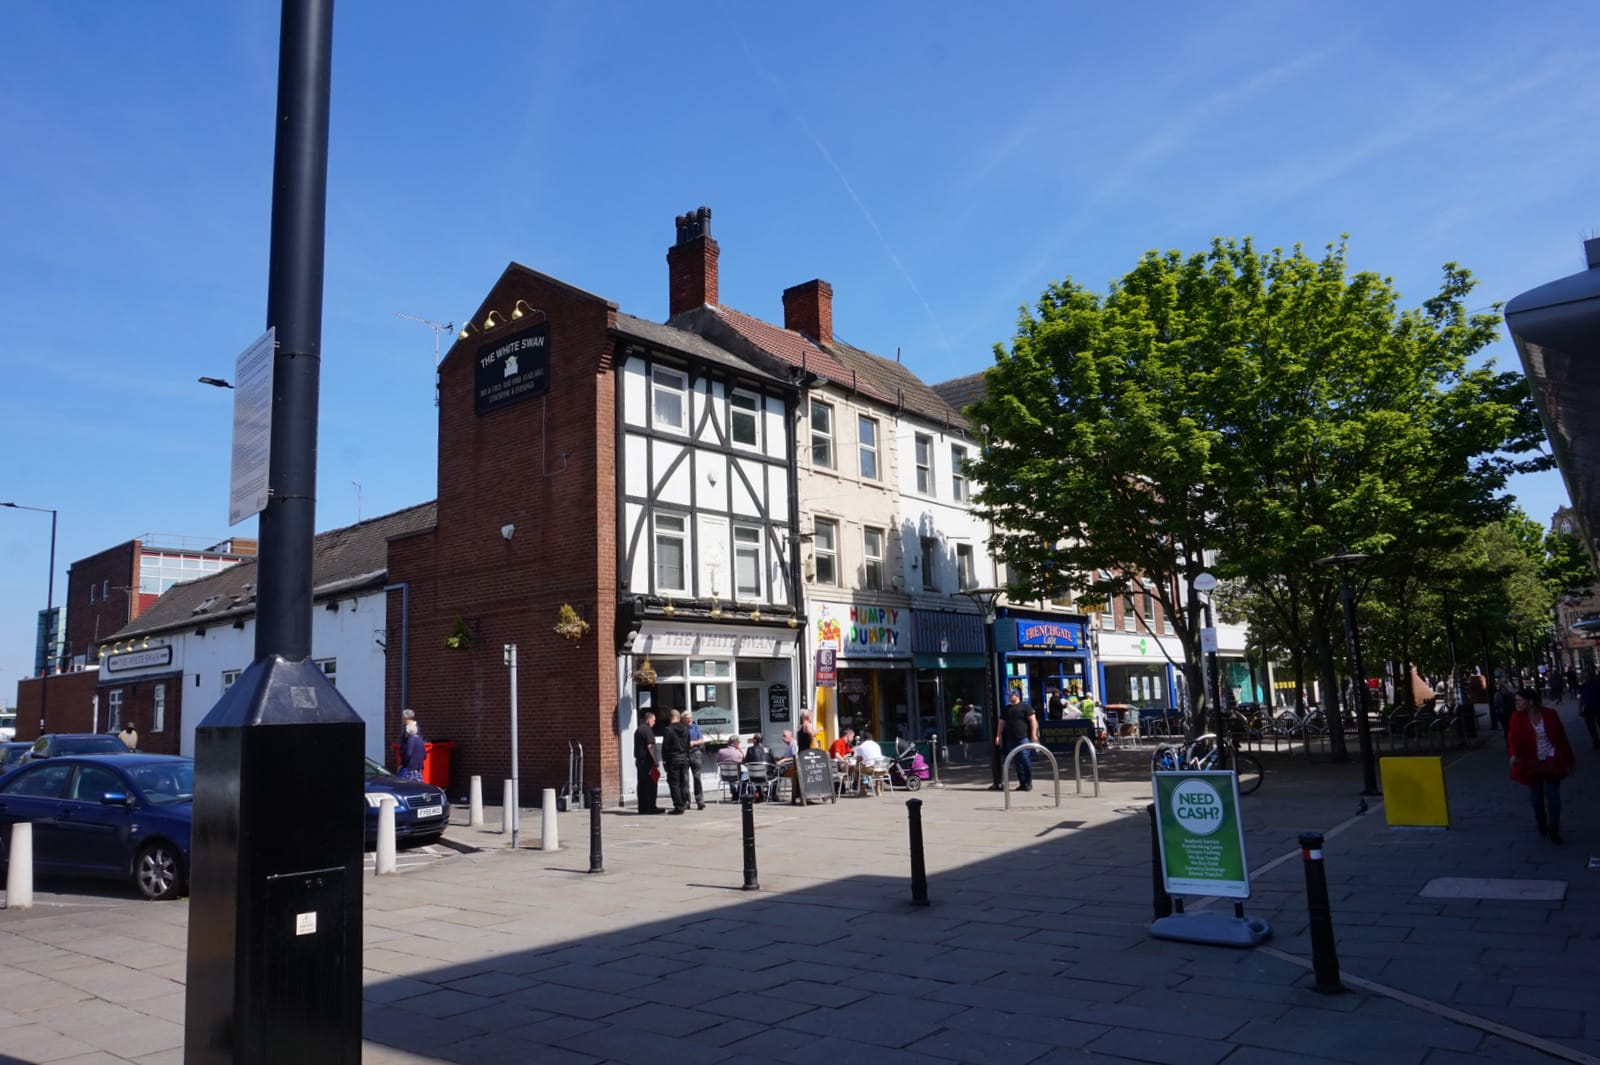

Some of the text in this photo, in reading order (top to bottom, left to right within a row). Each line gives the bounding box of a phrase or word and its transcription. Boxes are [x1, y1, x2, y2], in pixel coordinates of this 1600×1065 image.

[480, 336, 545, 368] THE WHITE SWAN
[850, 606, 898, 625] HUMPTY
[665, 631, 776, 648] THE WHITE SWAN
[850, 626, 899, 646] DUMPTY
[1025, 624, 1073, 642] FRENCHGATE
[128, 654, 144, 665] WHITE
[145, 653, 160, 662] SWAN
[1179, 793, 1214, 805] NEED
[1177, 807, 1219, 820] CASH?
